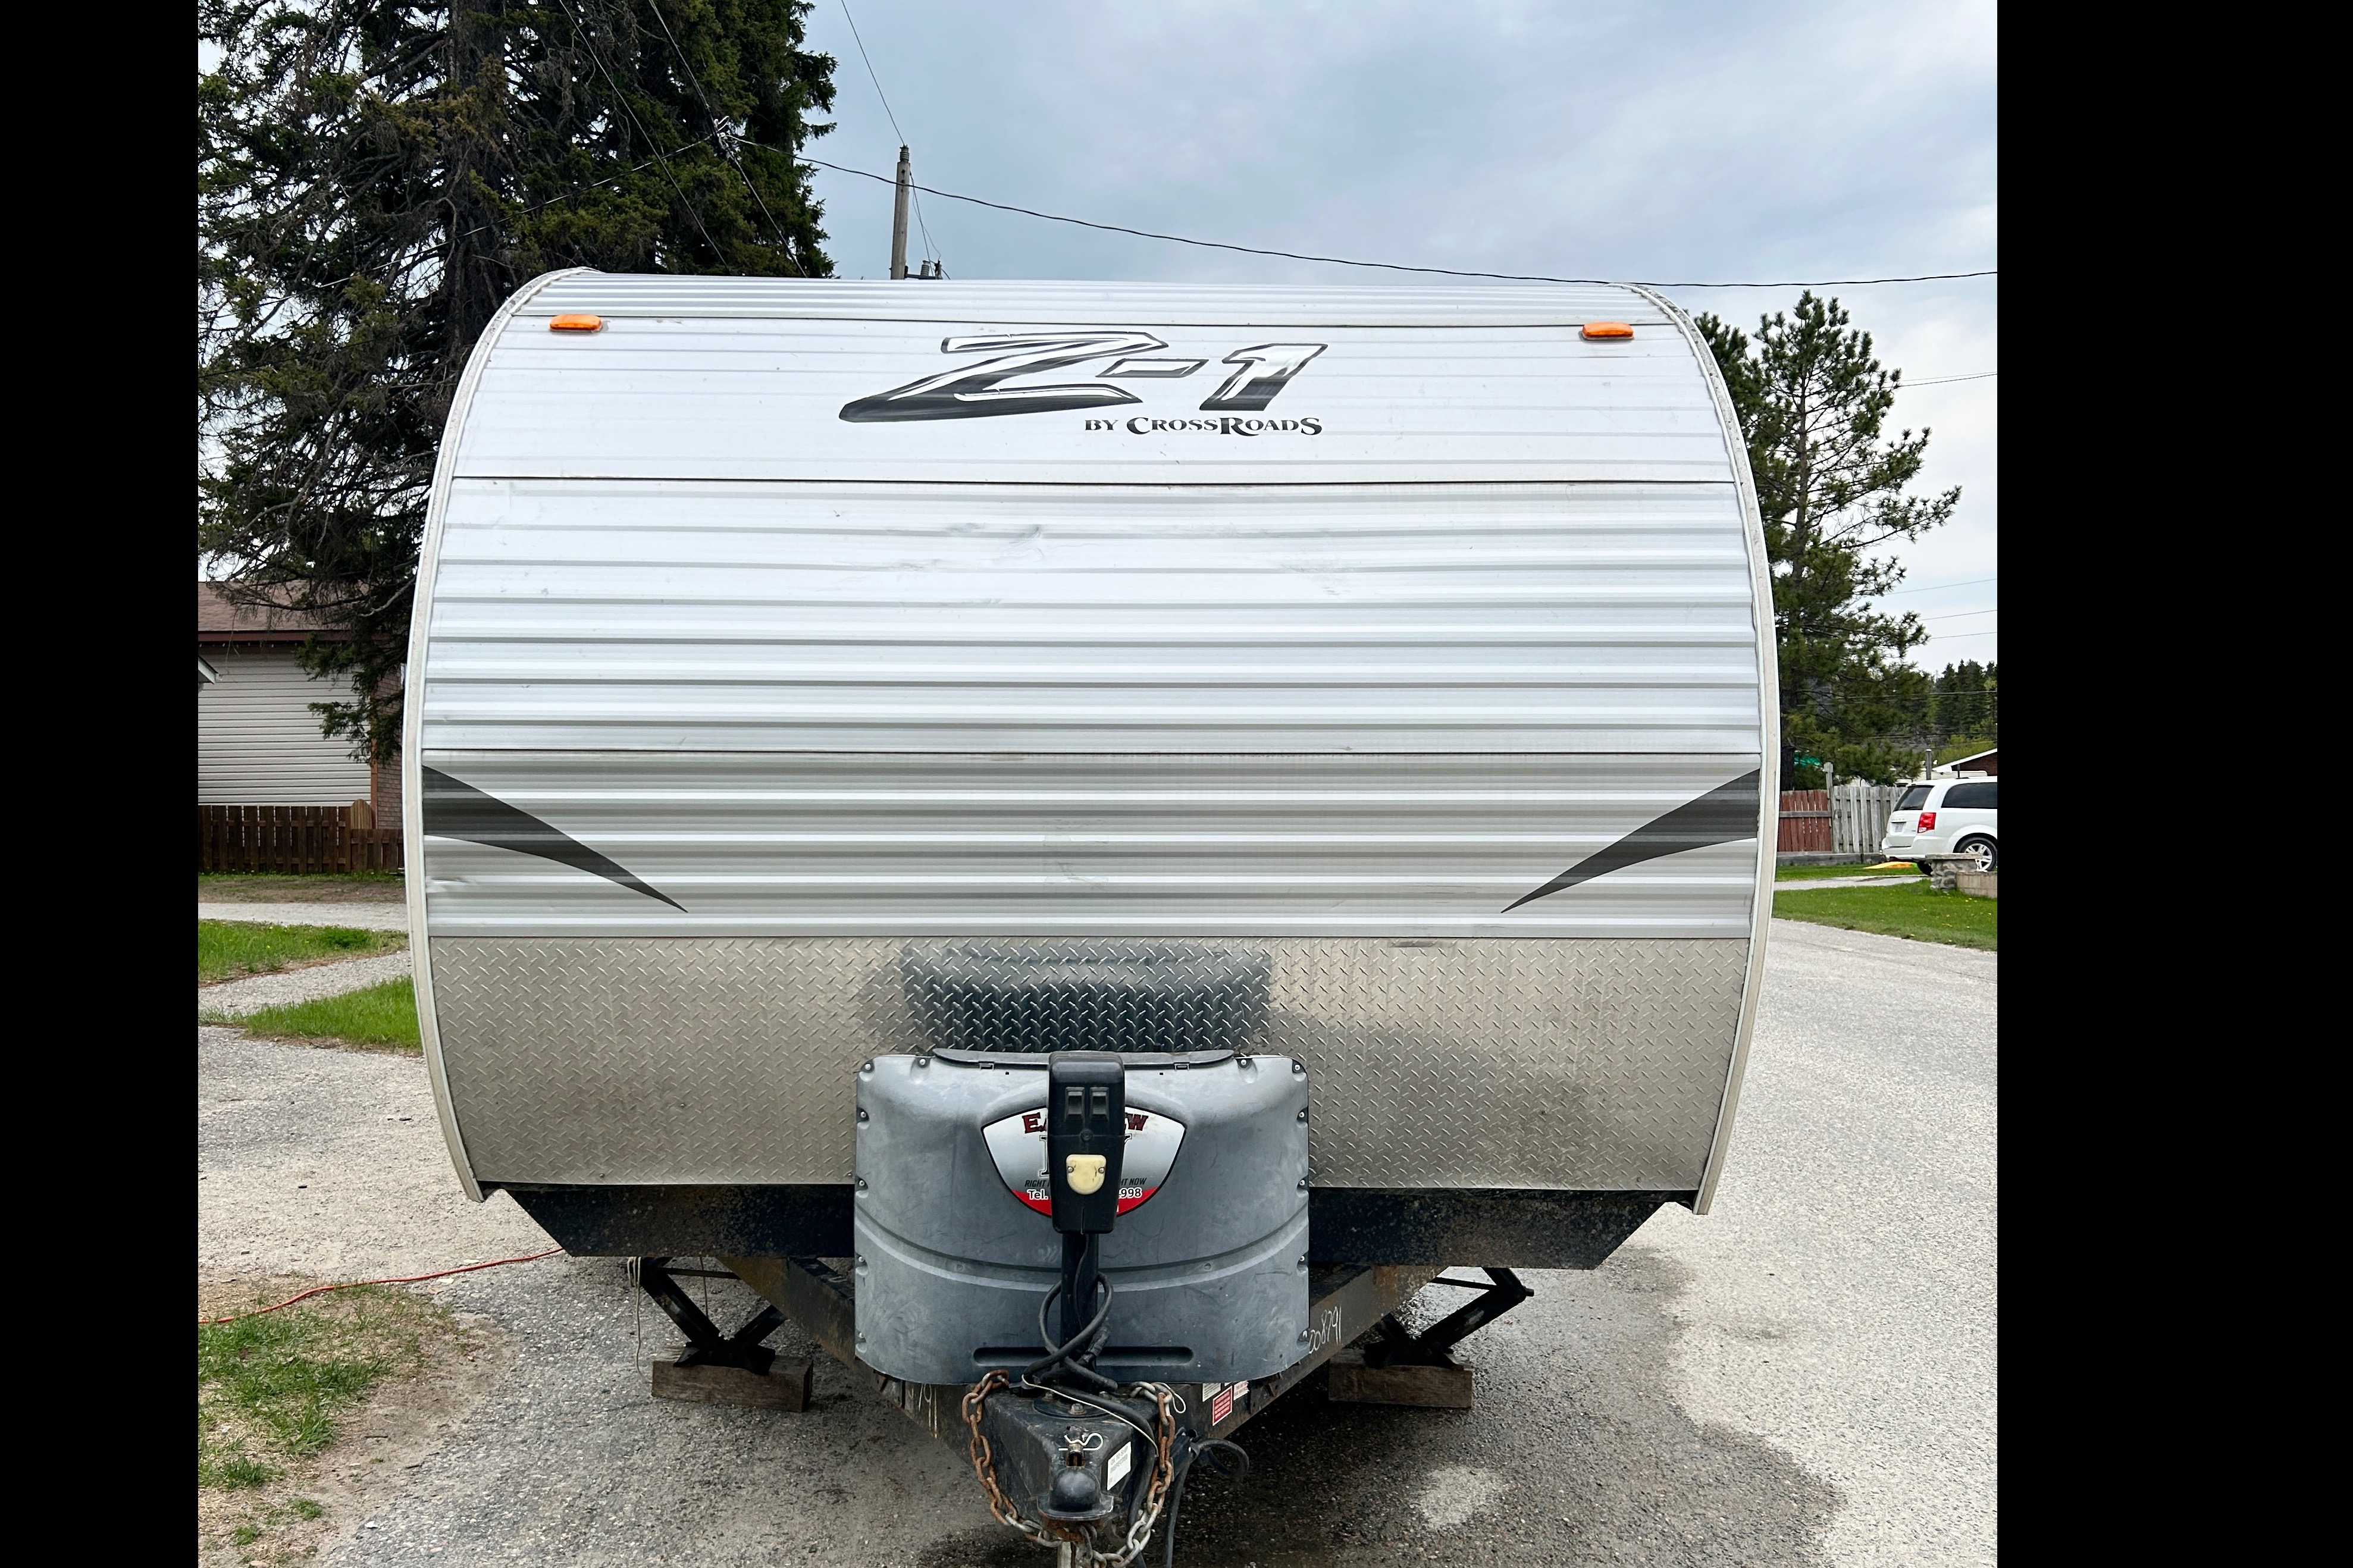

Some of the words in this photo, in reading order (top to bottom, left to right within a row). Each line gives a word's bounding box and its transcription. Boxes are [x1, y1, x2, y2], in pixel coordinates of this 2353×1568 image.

[839, 331, 1329, 423] Z-1
[1085, 419, 1118, 431] BY
[1129, 1177, 1147, 1186] NOW
[1027, 1189, 1048, 1199] Tel.
